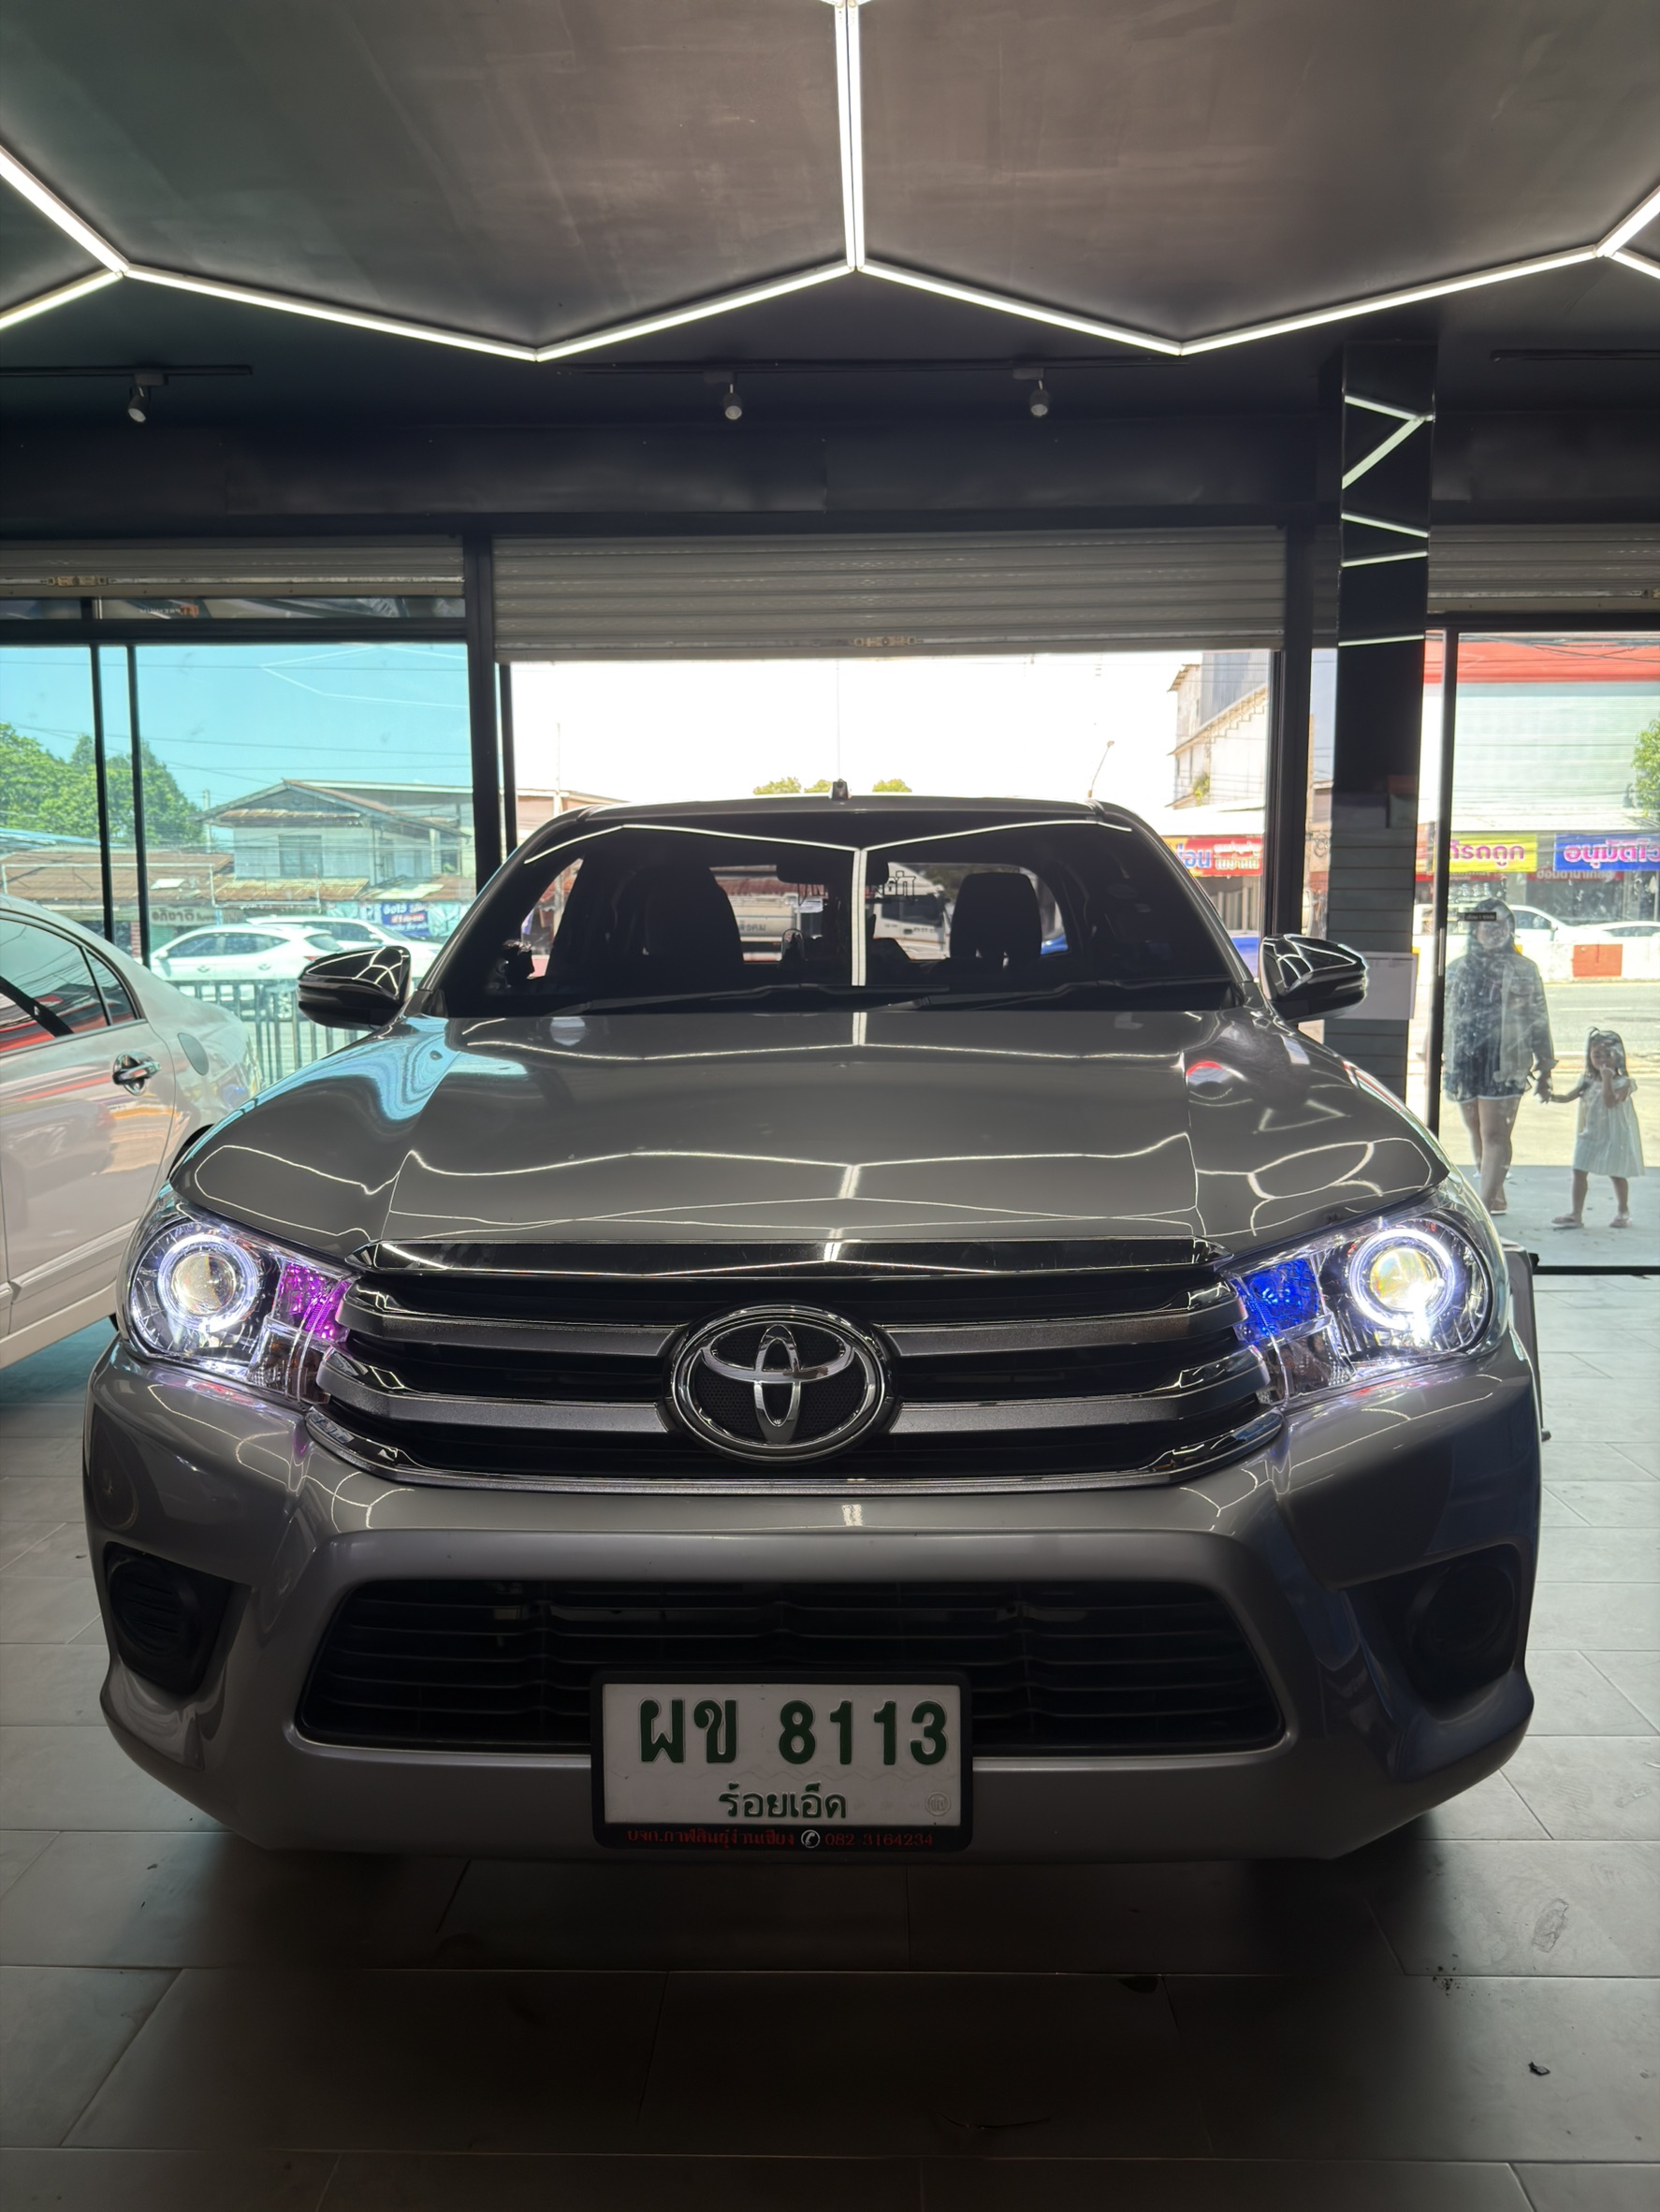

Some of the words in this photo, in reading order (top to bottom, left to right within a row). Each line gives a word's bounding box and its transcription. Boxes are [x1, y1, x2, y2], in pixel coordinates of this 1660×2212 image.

[1176, 843, 1212, 868] ่อน
[639, 1698, 737, 1764] ผข
[779, 1699, 947, 1766] 8113
[719, 1782, 847, 1818] ร้อยเอ็ด
